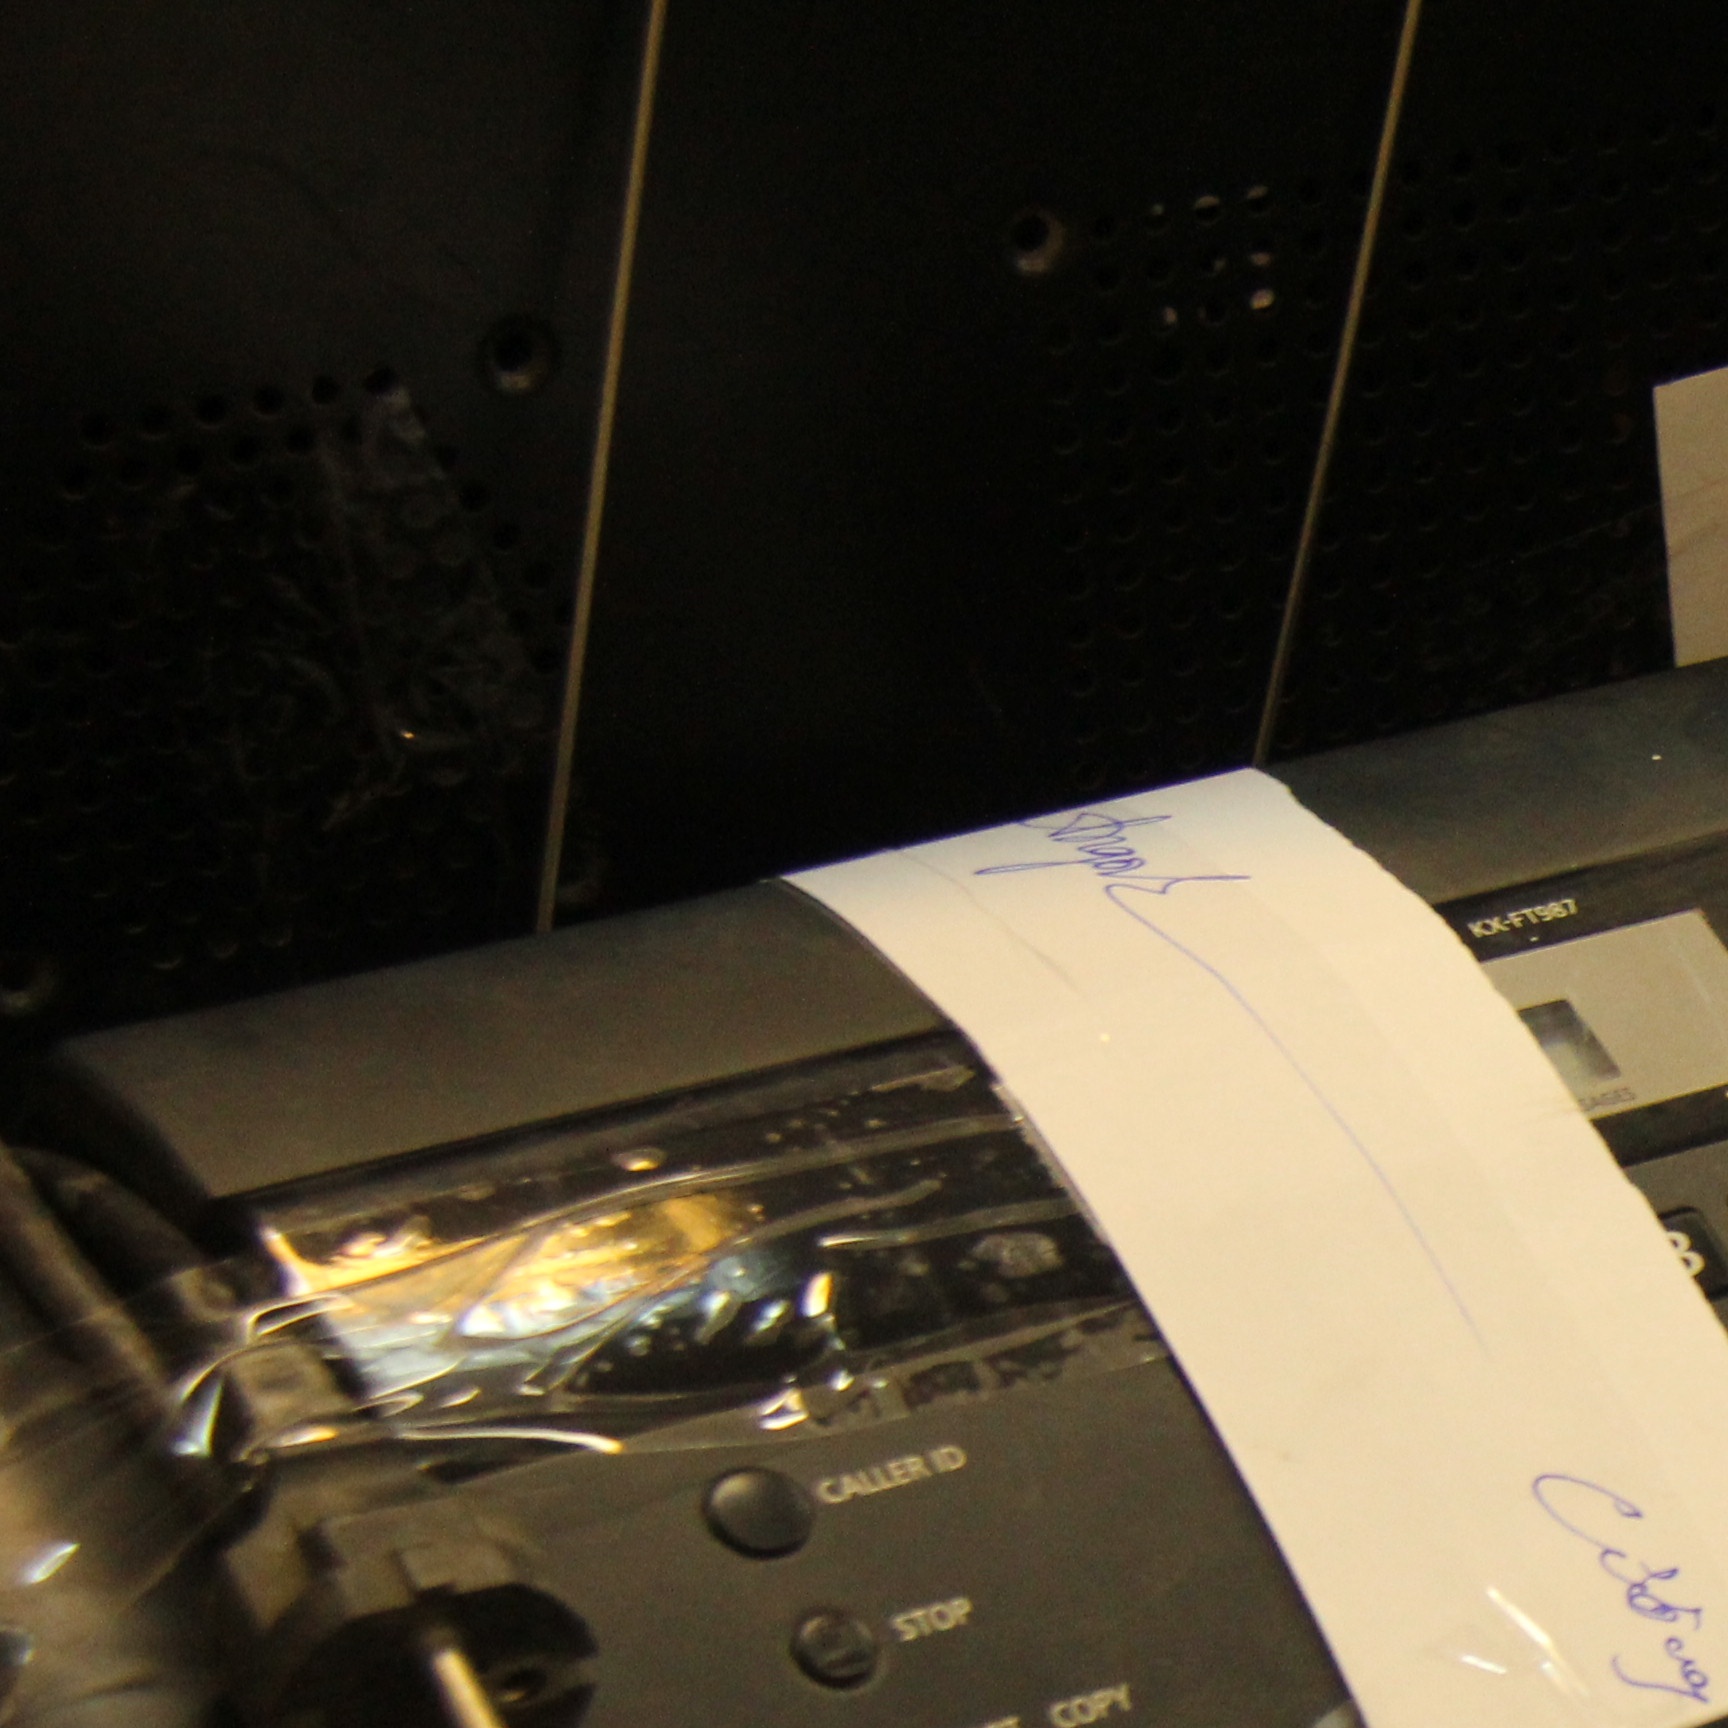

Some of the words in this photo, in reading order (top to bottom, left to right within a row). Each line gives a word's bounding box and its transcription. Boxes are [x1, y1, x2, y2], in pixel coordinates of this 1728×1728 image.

[1467, 898, 1580, 938] KX-FT987
[815, 1455, 926, 1504] CALLER
[926, 1445, 967, 1475] ID
[889, 1597, 973, 1642] STOP
